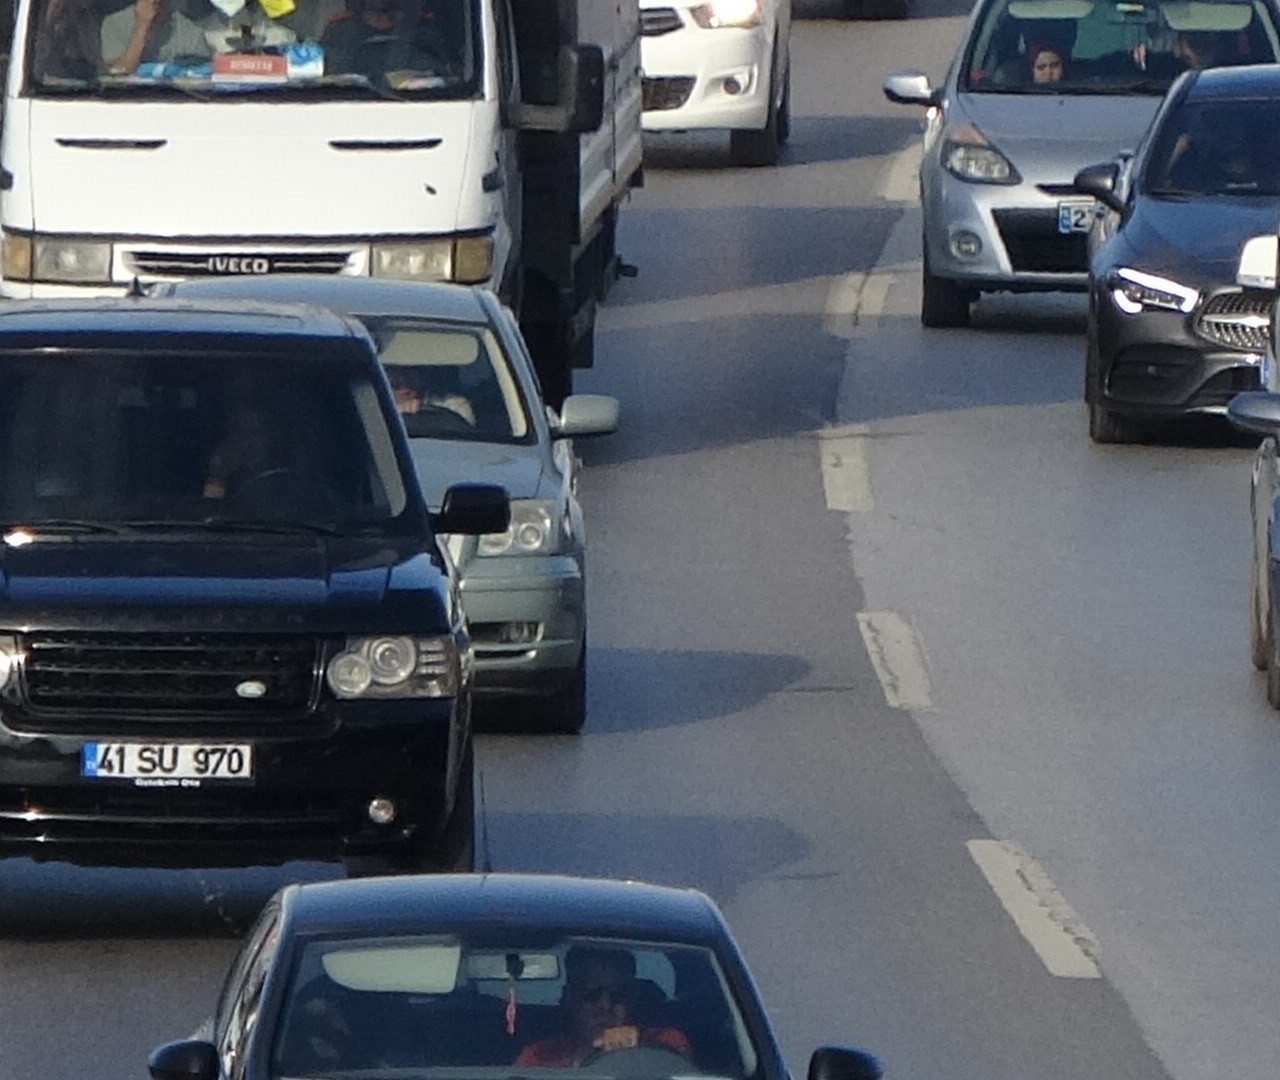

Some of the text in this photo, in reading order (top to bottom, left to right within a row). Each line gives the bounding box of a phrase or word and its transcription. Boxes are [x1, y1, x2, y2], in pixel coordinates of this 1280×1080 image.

[208, 256, 269, 273] IVECO
[98, 746, 126, 774] 41
[137, 746, 179, 773] SU
[194, 747, 244, 775] 970
